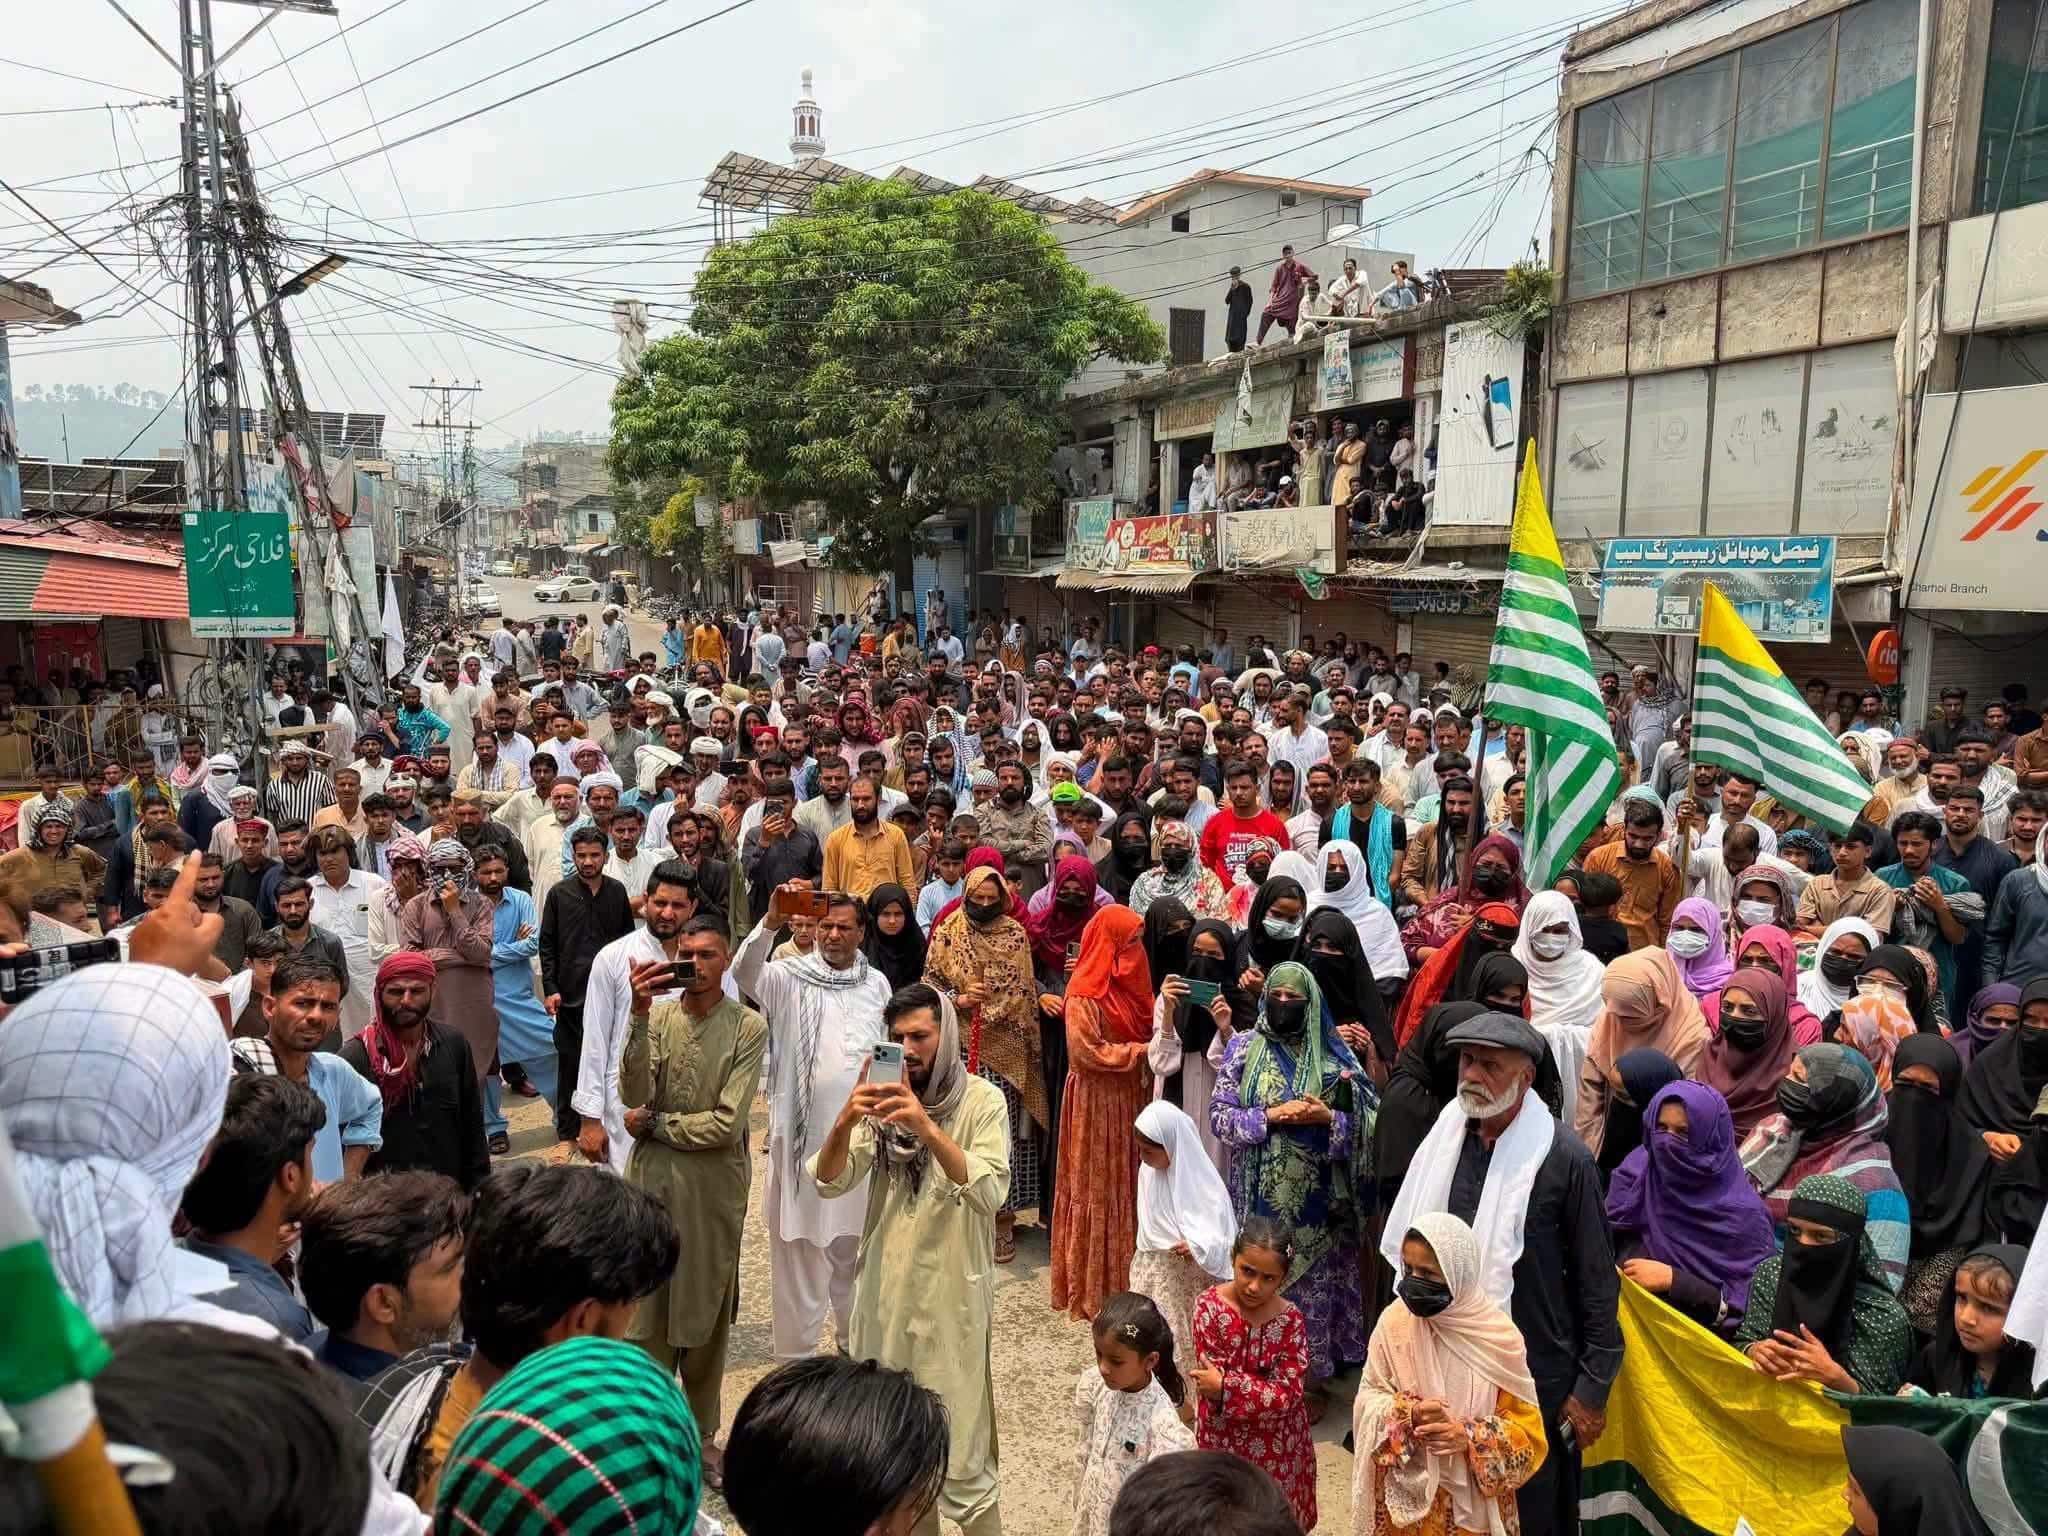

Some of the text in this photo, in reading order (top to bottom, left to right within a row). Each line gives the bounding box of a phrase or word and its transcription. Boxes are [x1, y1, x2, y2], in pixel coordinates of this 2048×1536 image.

[195, 523, 284, 575] فلاحی مرکز
[1615, 543, 1643, 564] لیب
[1771, 538, 1820, 565] فیصل
[1950, 583, 1988, 594] Branch
